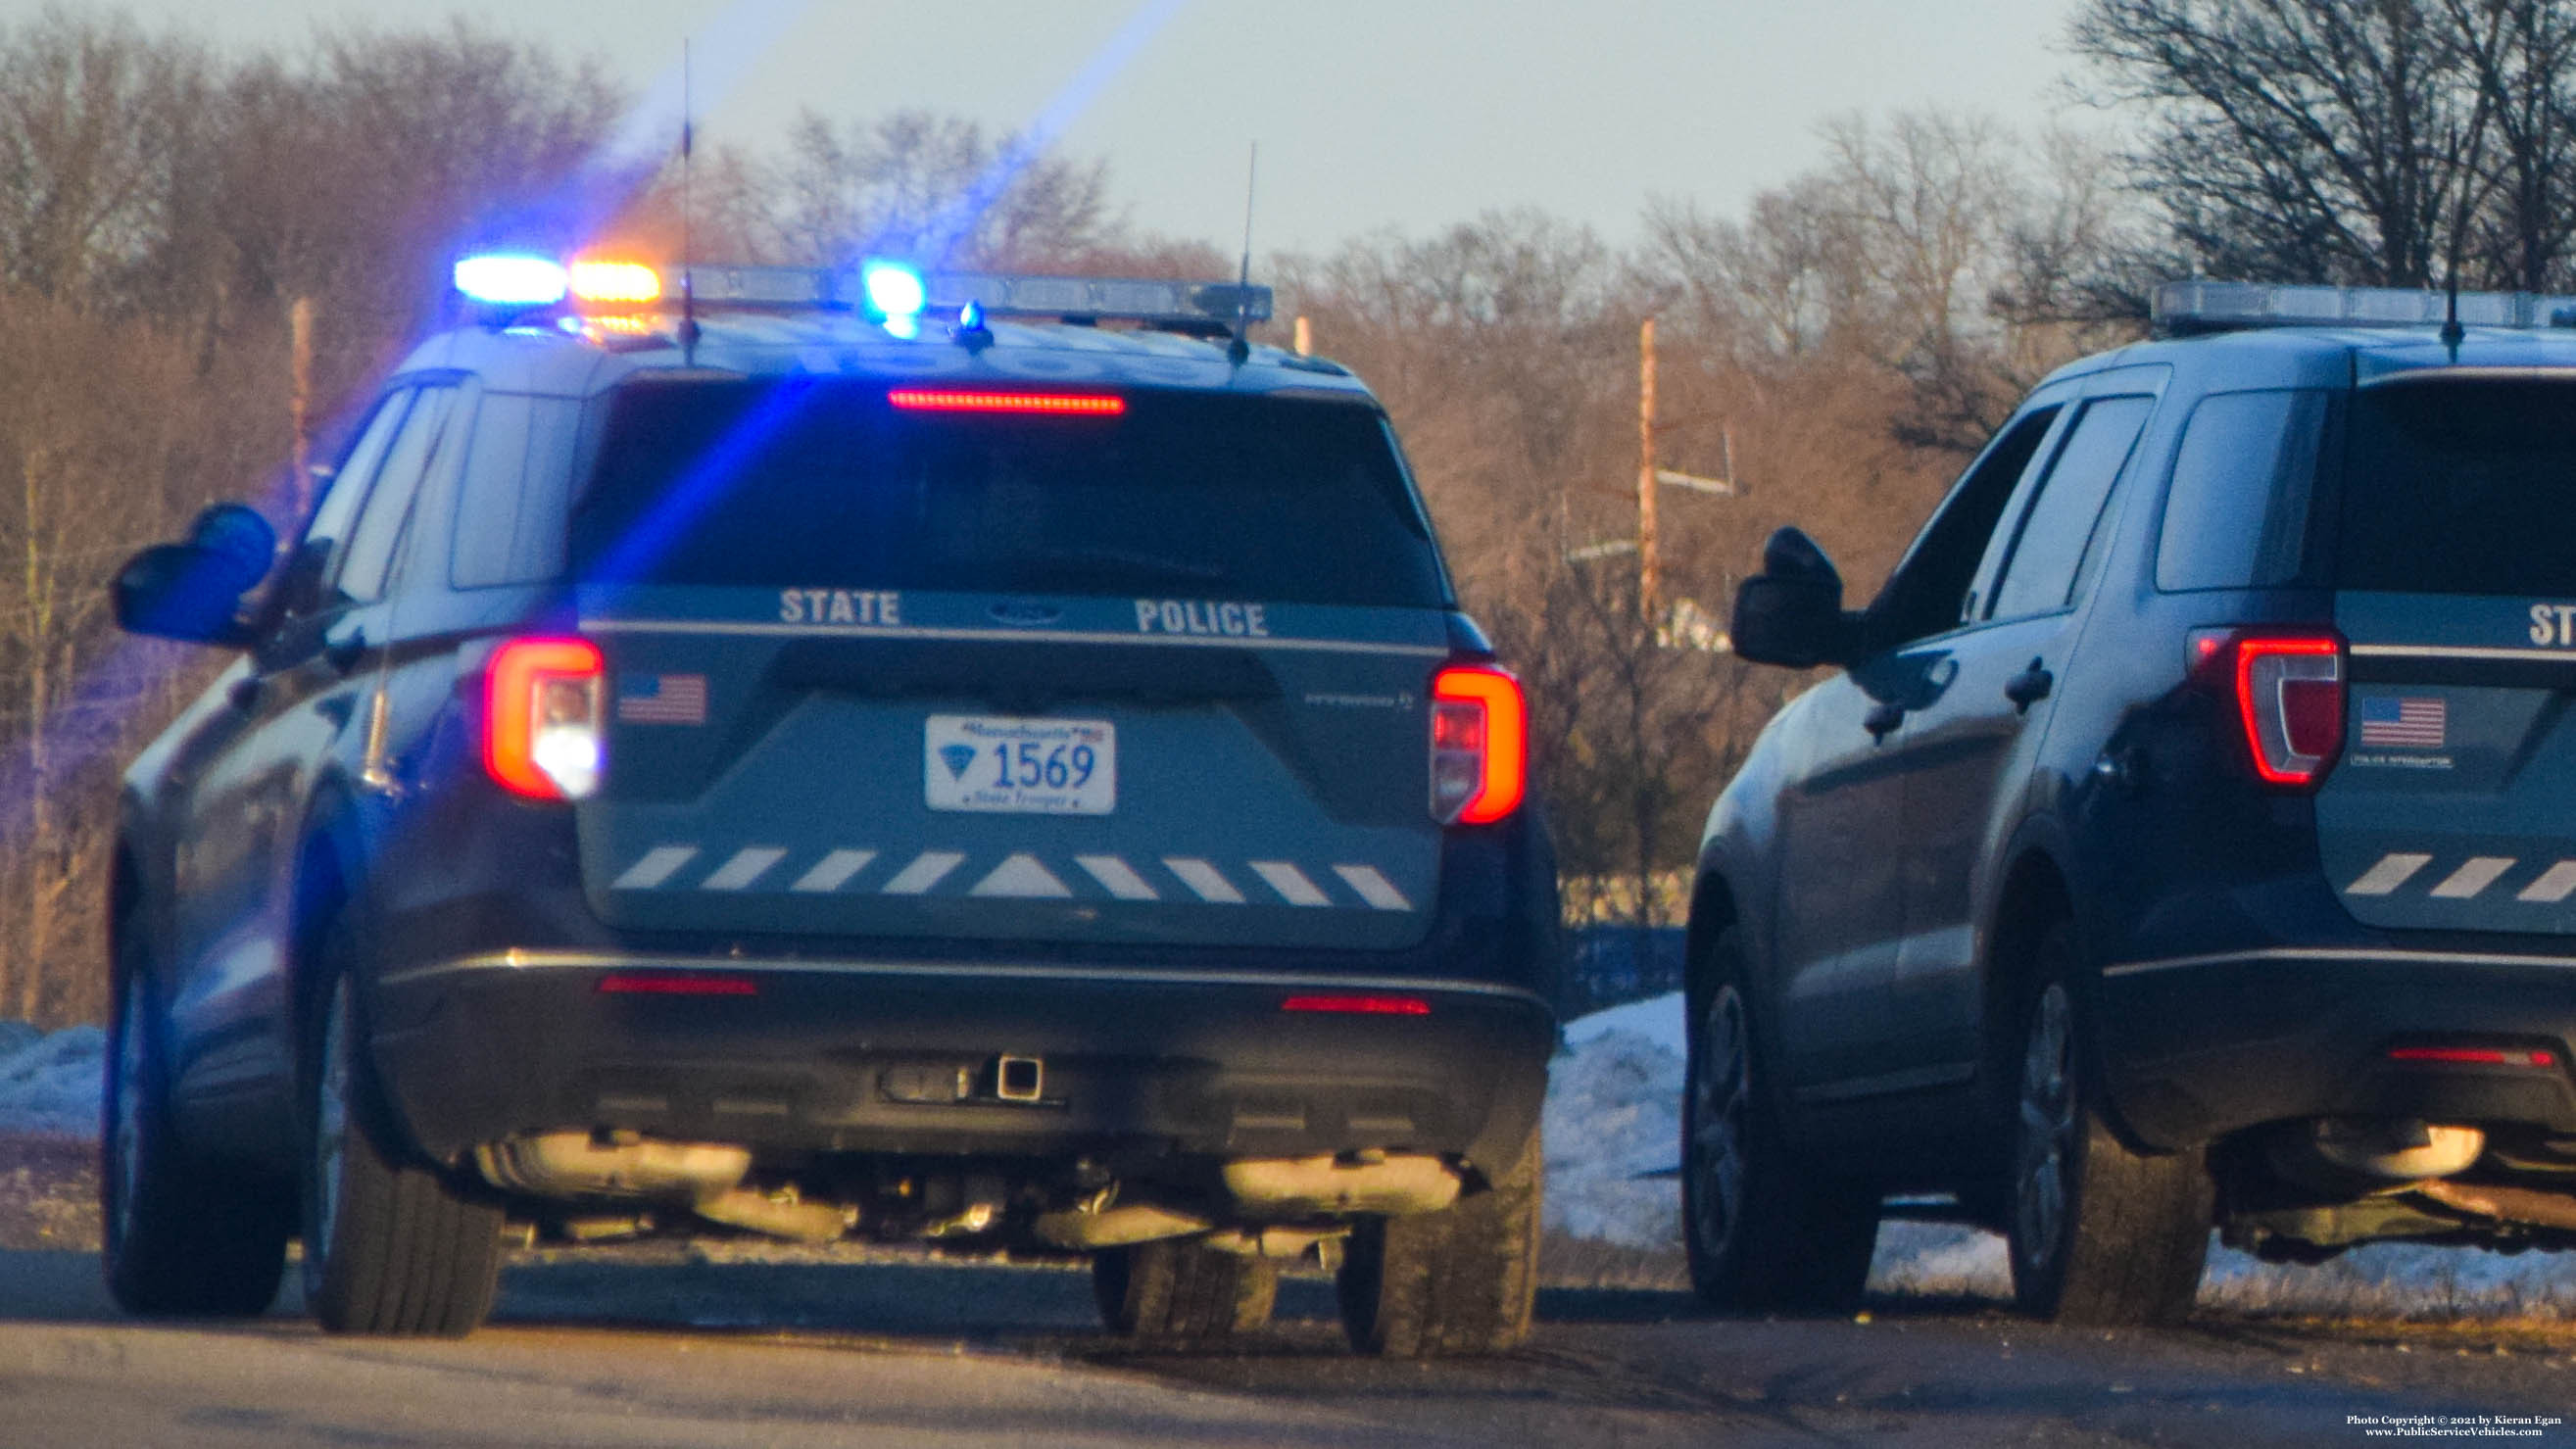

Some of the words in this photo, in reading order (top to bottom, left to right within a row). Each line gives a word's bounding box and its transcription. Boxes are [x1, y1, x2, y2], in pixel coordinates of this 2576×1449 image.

[780, 589, 900, 625] STATE
[1135, 598, 1268, 636] POLICE
[993, 743, 1095, 790] 1569
